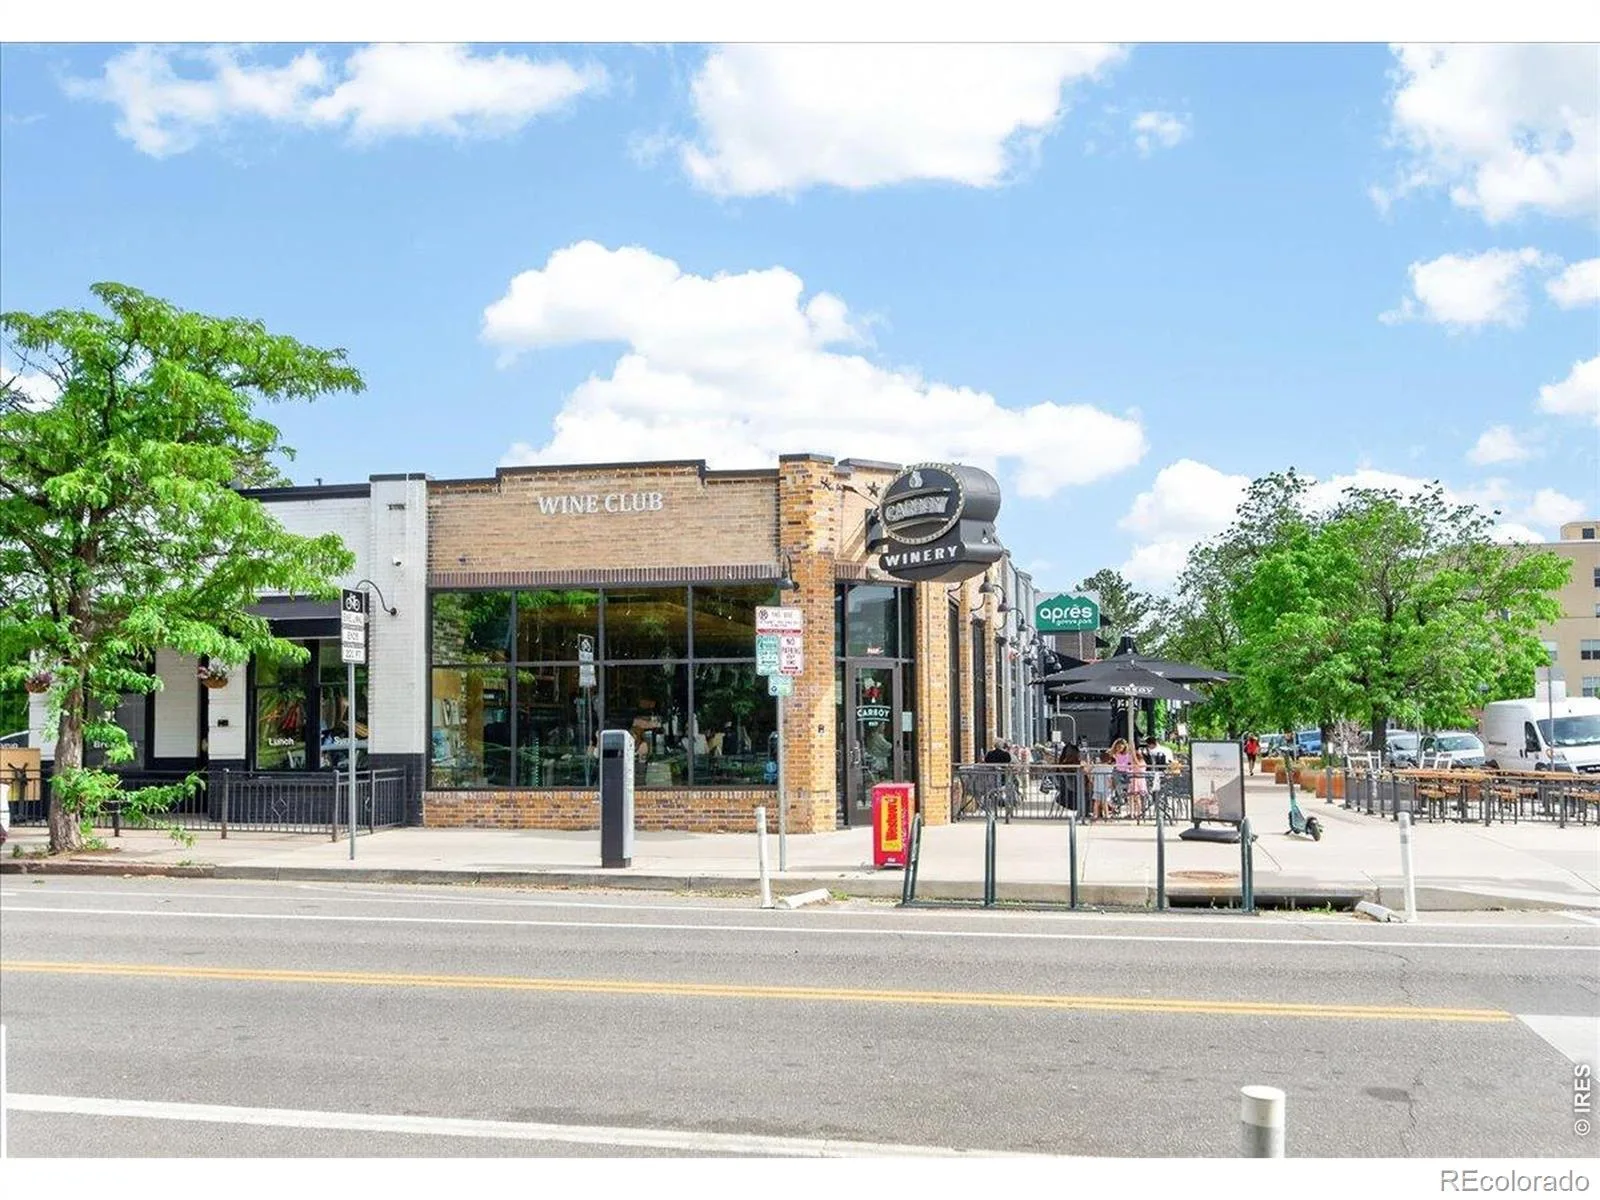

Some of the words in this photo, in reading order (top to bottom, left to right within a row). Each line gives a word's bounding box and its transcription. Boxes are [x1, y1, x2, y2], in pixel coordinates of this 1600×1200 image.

[538, 494, 600, 515] WINE
[604, 491, 664, 513] CLUB
[884, 545, 958, 567] WINERY
[1039, 604, 1093, 624] après
[856, 708, 890, 718] CARBOY
[268, 737, 295, 747] Lunch
